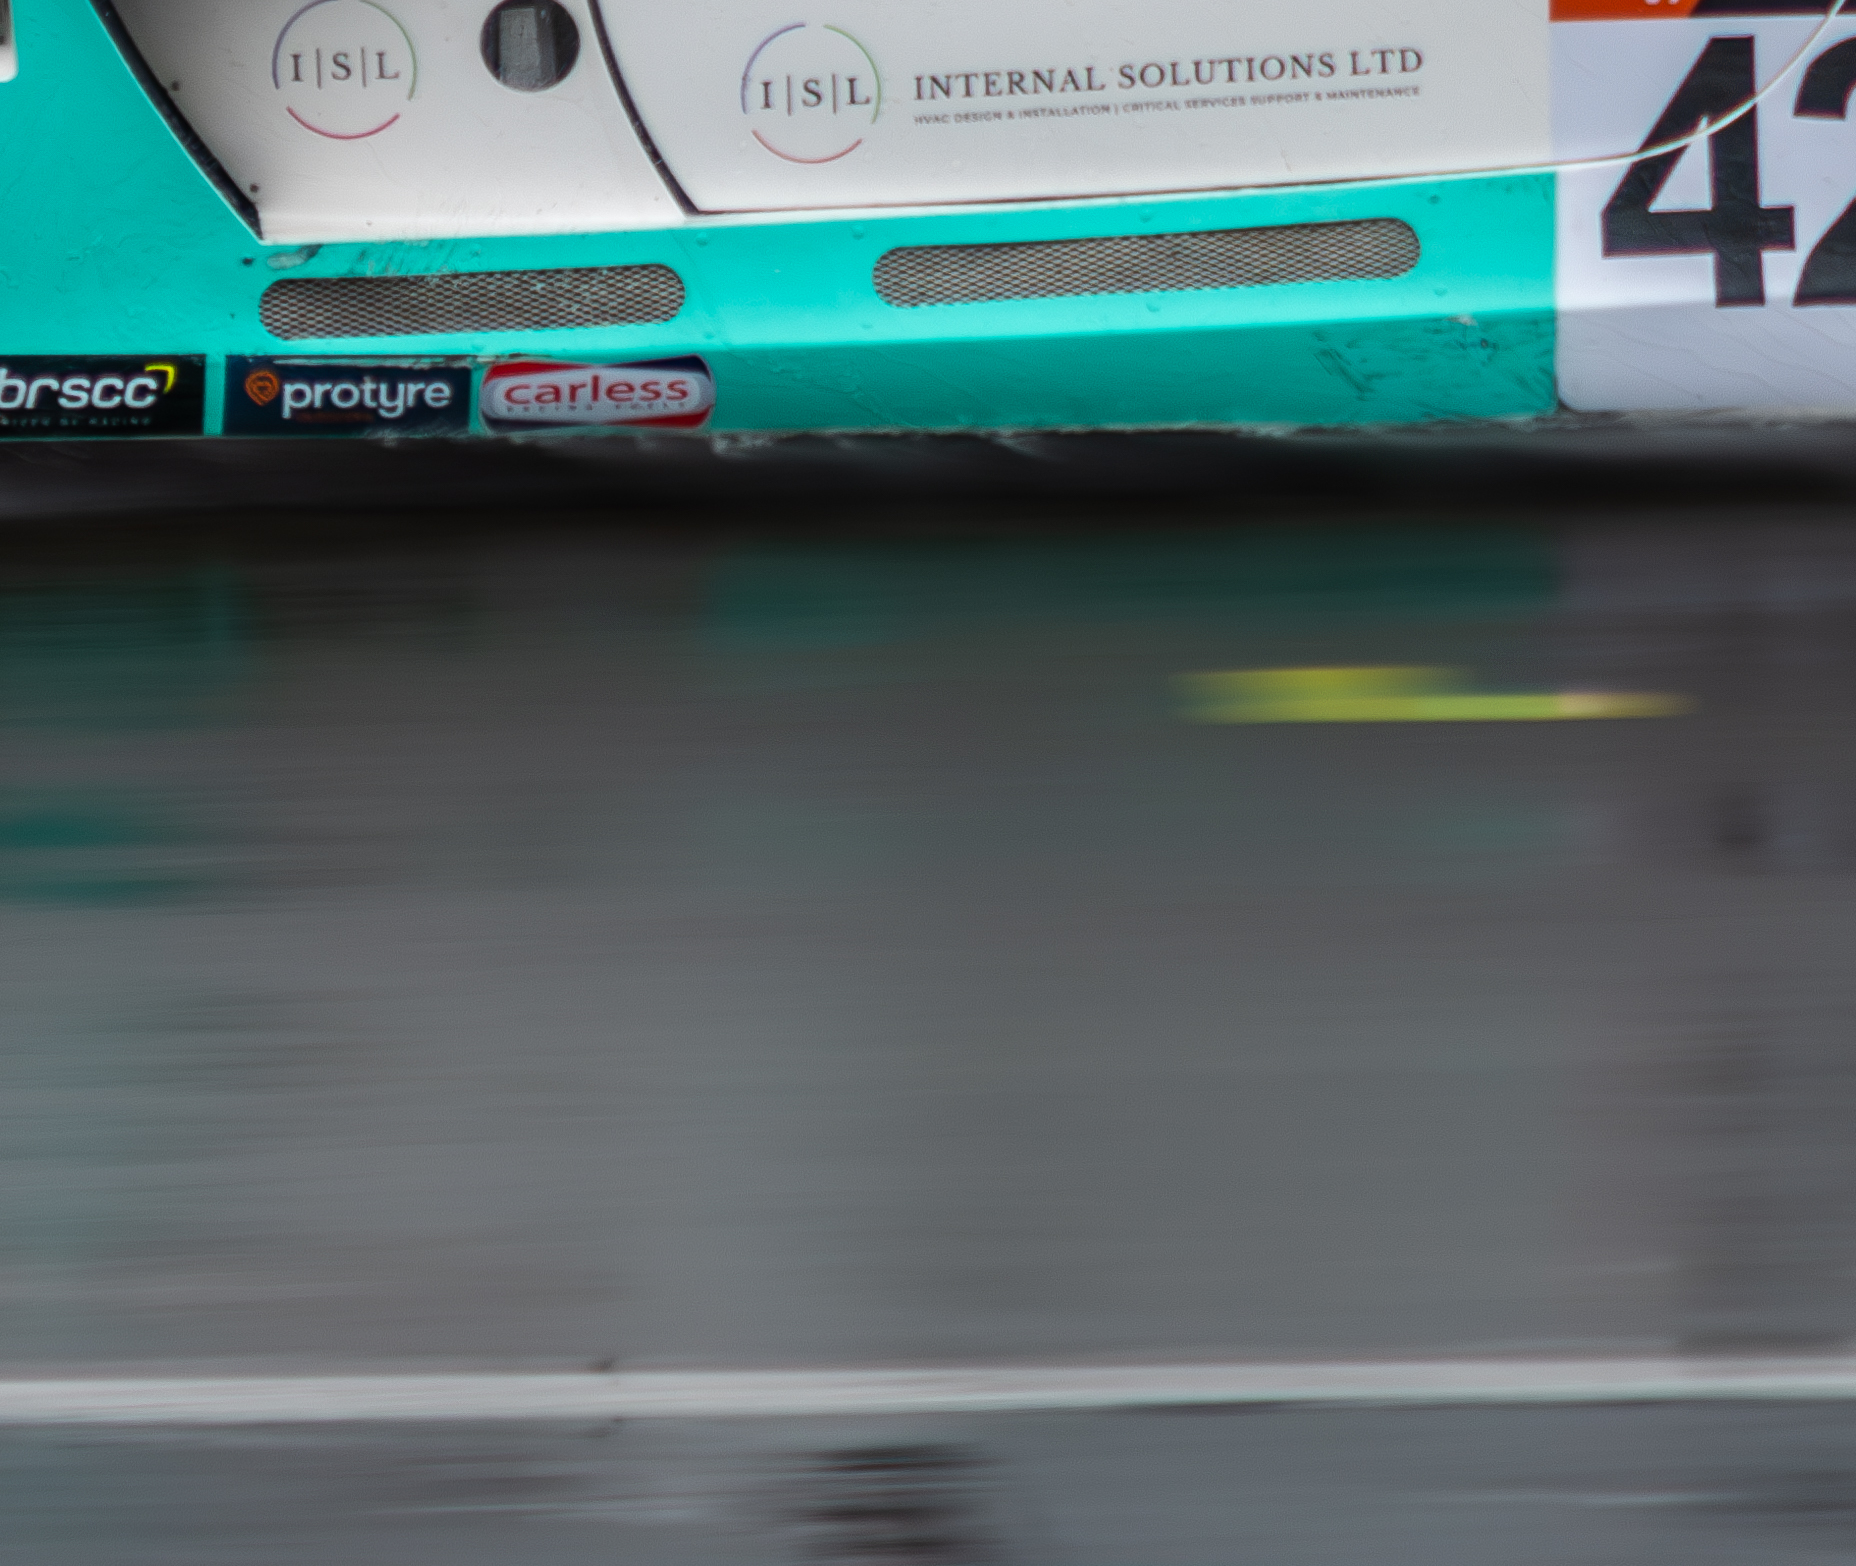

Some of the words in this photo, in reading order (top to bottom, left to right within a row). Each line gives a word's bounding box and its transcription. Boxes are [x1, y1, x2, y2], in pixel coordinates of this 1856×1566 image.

[914, 66, 1107, 101] INTERNAL
[1117, 51, 1337, 90] SOLUTIONS
[1349, 47, 1424, 77] LTD
[954, 109, 1002, 124] DESIGN
[1122, 99, 1181, 114] CRITICAL
[1184, 96, 1246, 110] SERVICES
[1250, 91, 1310, 106] SUPPORT
[1326, 85, 1421, 102] MAINTENANCE
[281, 375, 451, 420] protyre
[503, 374, 690, 406] carless
